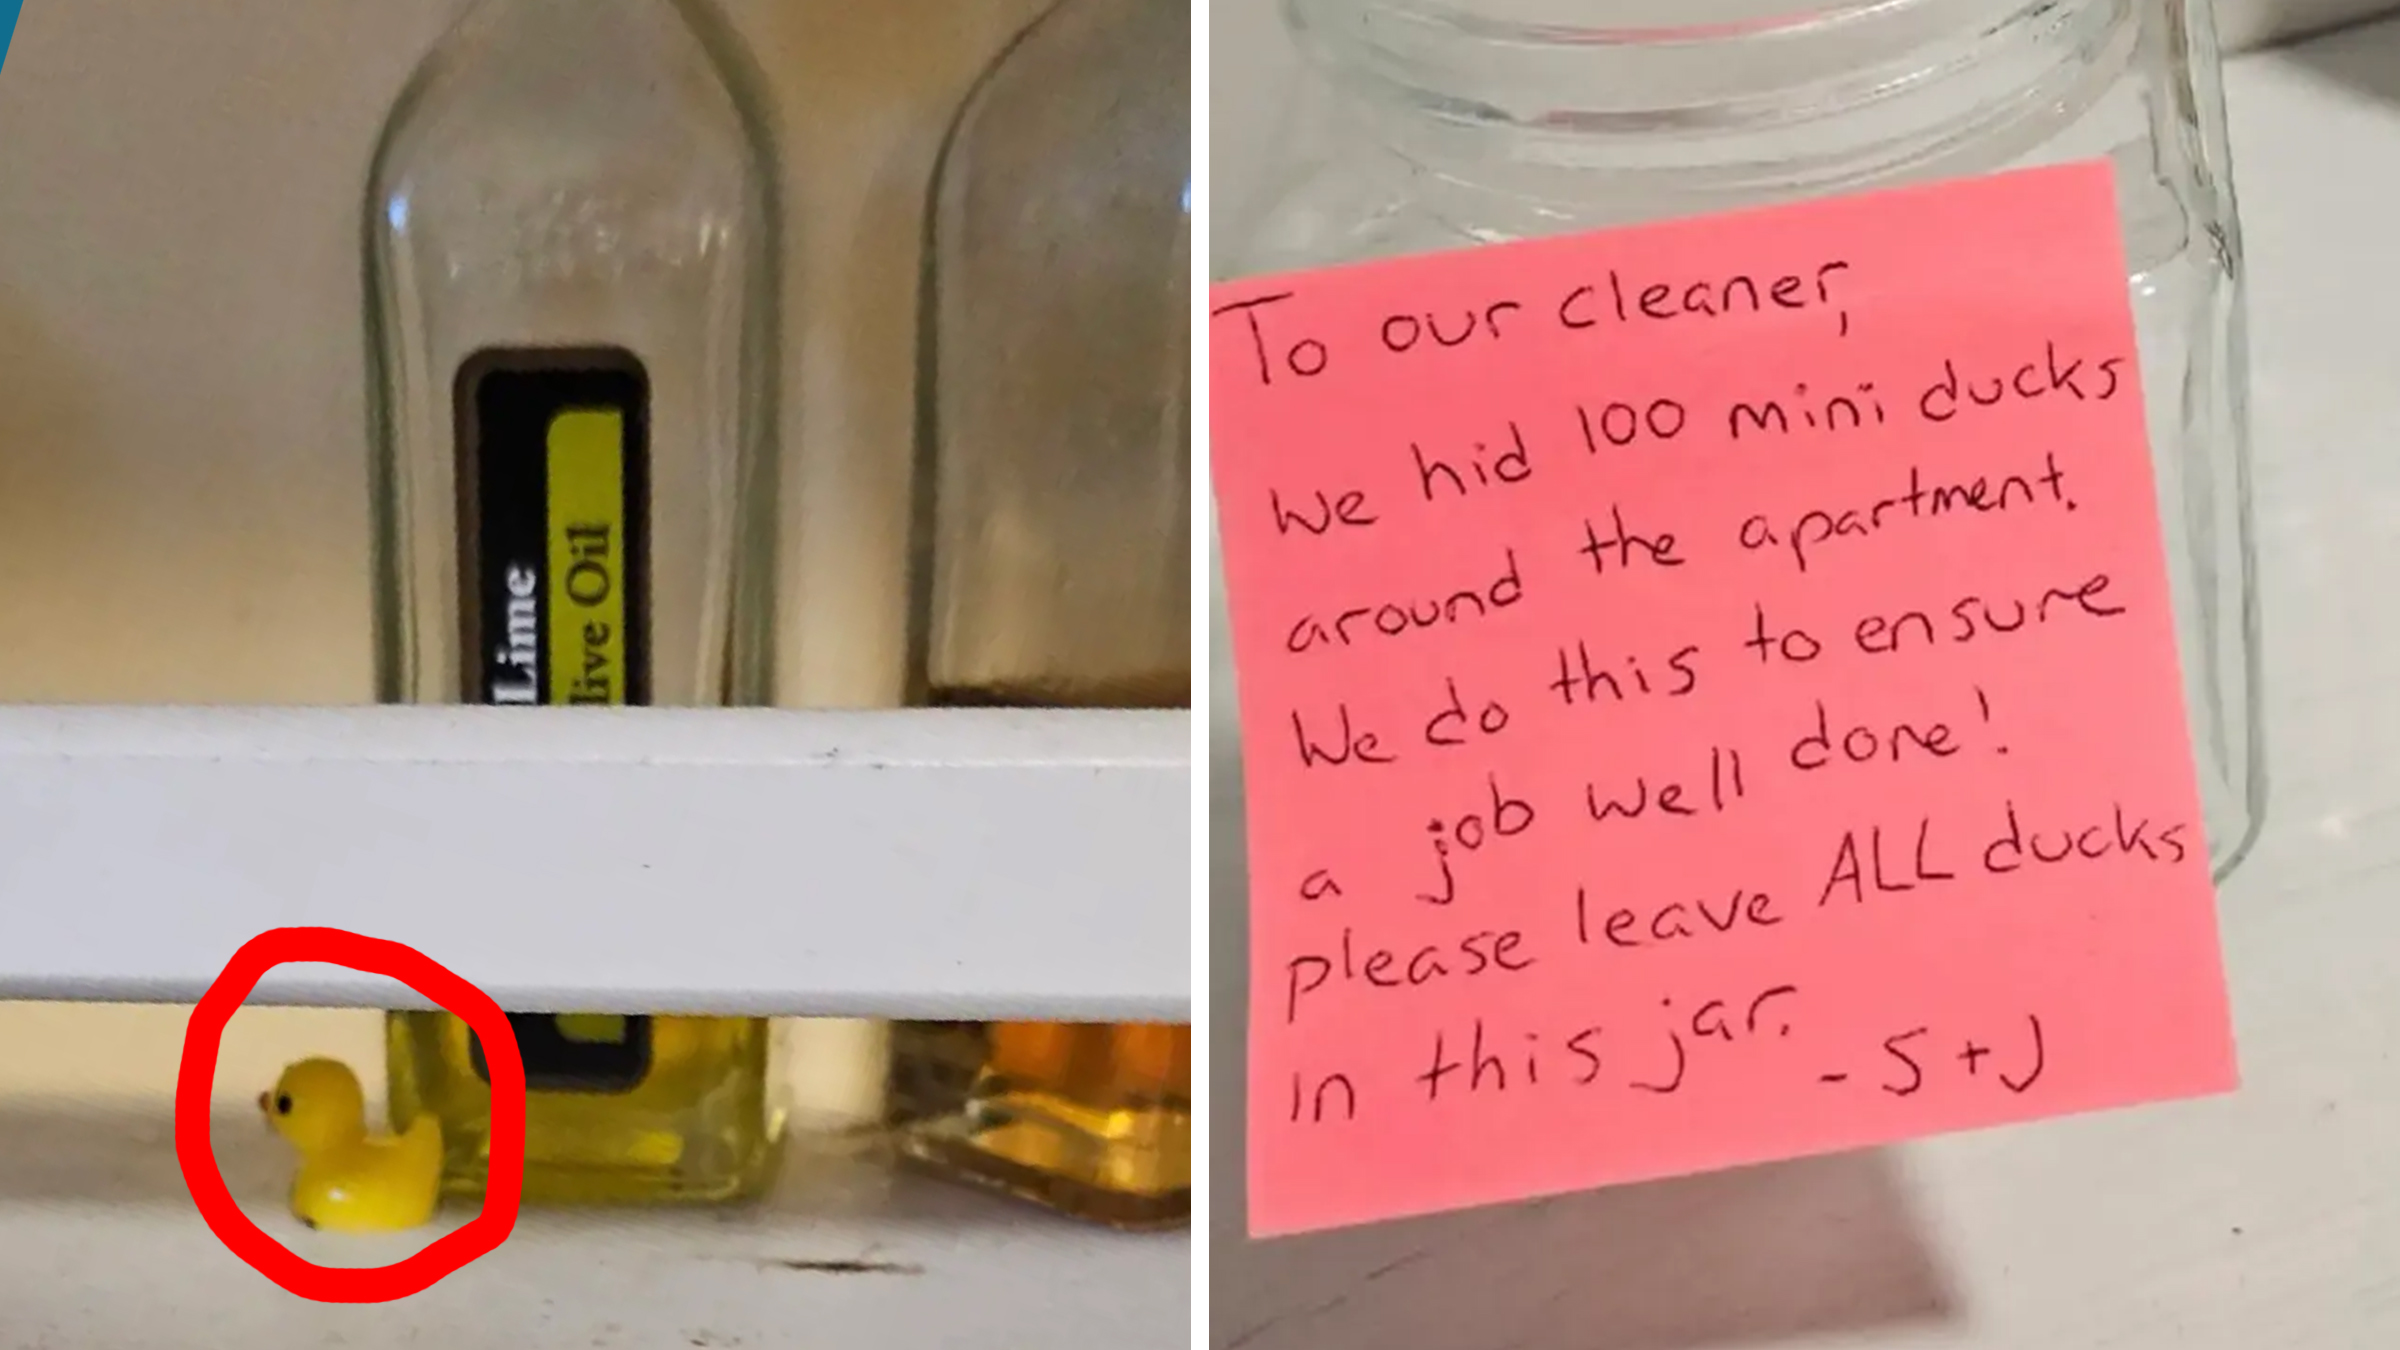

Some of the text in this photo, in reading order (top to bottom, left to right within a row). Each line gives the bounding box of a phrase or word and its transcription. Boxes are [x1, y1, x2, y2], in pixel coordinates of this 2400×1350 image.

[1212, 259, 1849, 386] To our cleaner,
[1409, 420, 1533, 502] hid
[1576, 397, 1687, 455] 100
[1727, 381, 1885, 441] mini
[1918, 340, 2123, 424] ducks
[492, 563, 537, 705] Lime
[565, 522, 611, 705] live Oil
[1285, 451, 2078, 654] around the apartment.
[1290, 573, 2127, 769] We do this to ensure
[1299, 685, 2010, 906] a job well done!
[1287, 800, 2186, 1024] please leave ALL ducks
[1417, 1017, 1603, 1101] this
[1627, 983, 1798, 1095] jar.
